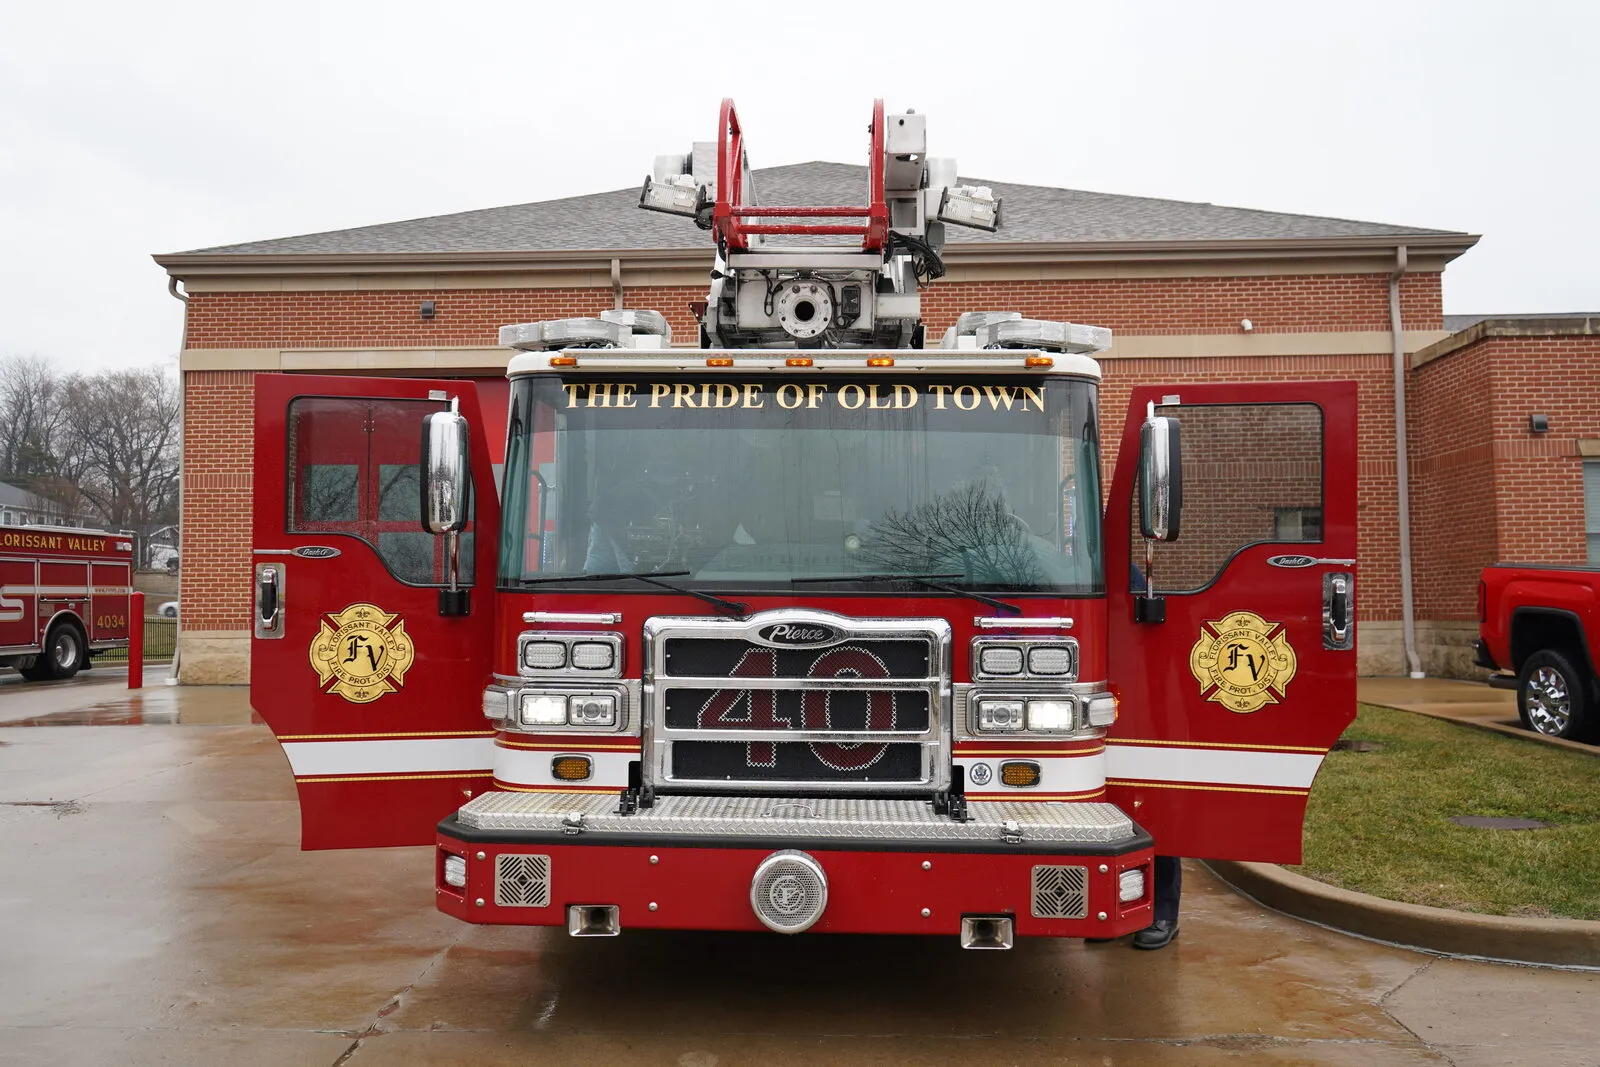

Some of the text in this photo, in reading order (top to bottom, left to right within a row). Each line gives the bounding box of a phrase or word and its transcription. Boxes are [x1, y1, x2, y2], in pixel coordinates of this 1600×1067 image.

[562, 383, 1047, 412] THE PRIDE OF OLD TOWN
[68, 538, 106, 551] VALLEY
[97, 615, 125, 628] 4034
[768, 624, 825, 642] Pierce
[329, 622, 396, 652] FLORISSANT VALLEY
[1209, 630, 1277, 661] FLORISSANT VALLEY
[331, 661, 394, 685] FIRE PROT. DIST.
[1211, 669, 1276, 694] FIRE PROT. DIST.
[697, 647, 896, 771] 40
